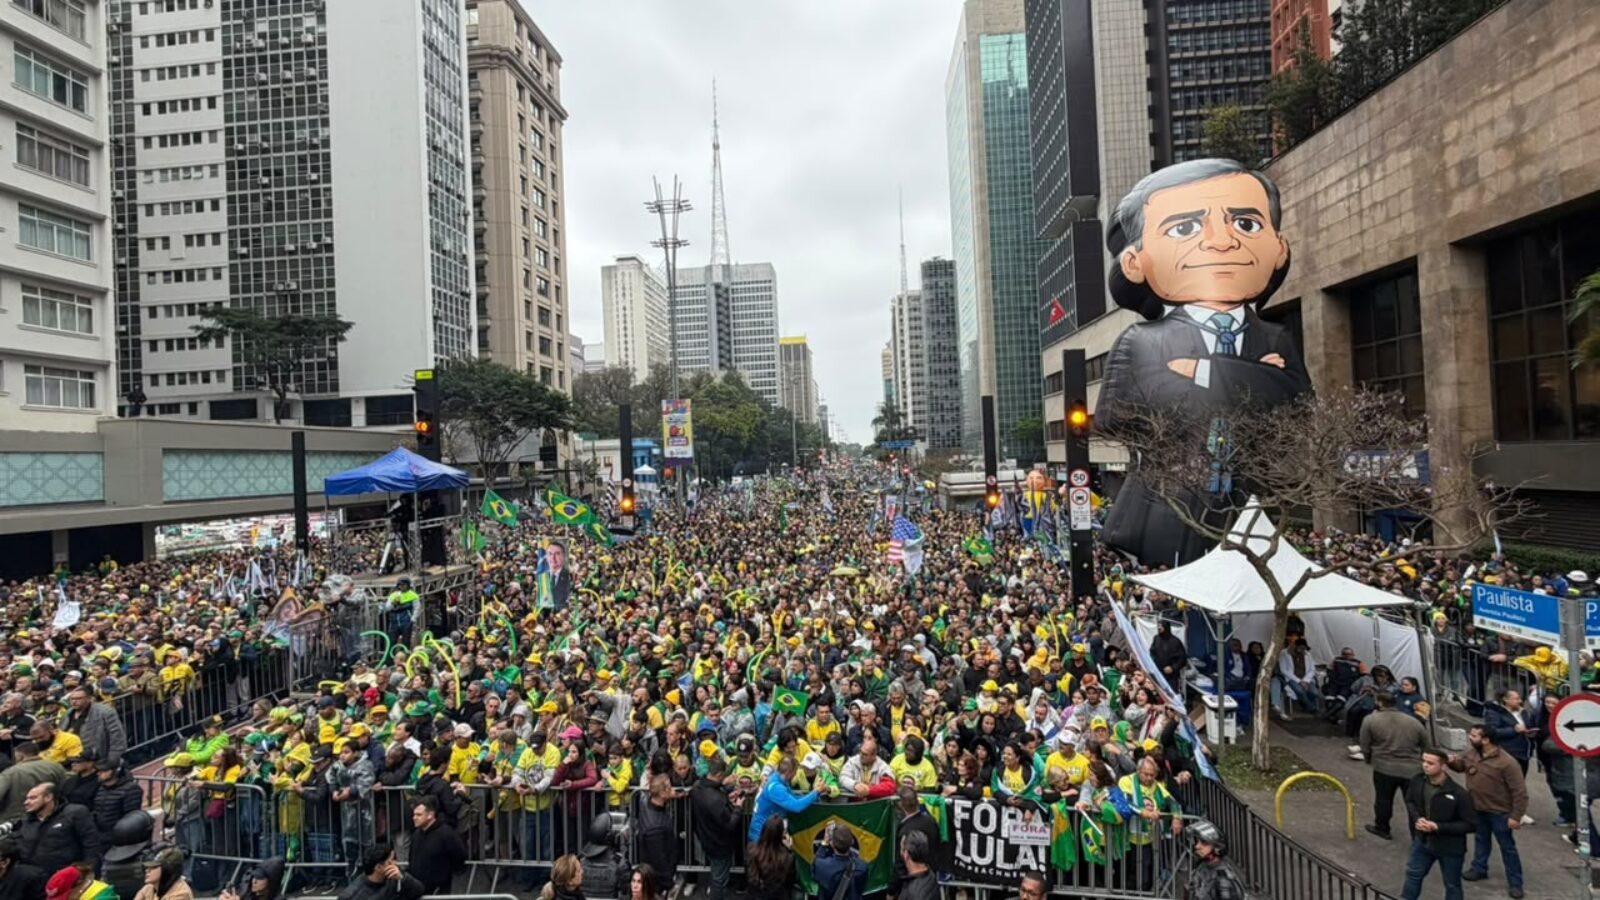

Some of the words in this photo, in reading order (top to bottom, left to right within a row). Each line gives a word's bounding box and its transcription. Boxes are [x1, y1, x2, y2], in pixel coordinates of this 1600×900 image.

[1073, 474, 1086, 482] 50
[1476, 586, 1535, 613] Paulista
[1502, 612, 1526, 622] Paulista
[954, 800, 1045, 838] FORA
[1013, 825, 1047, 834] FORA
[955, 830, 1046, 872] LULA!
[954, 859, 1026, 878] IMPEACHMEN
